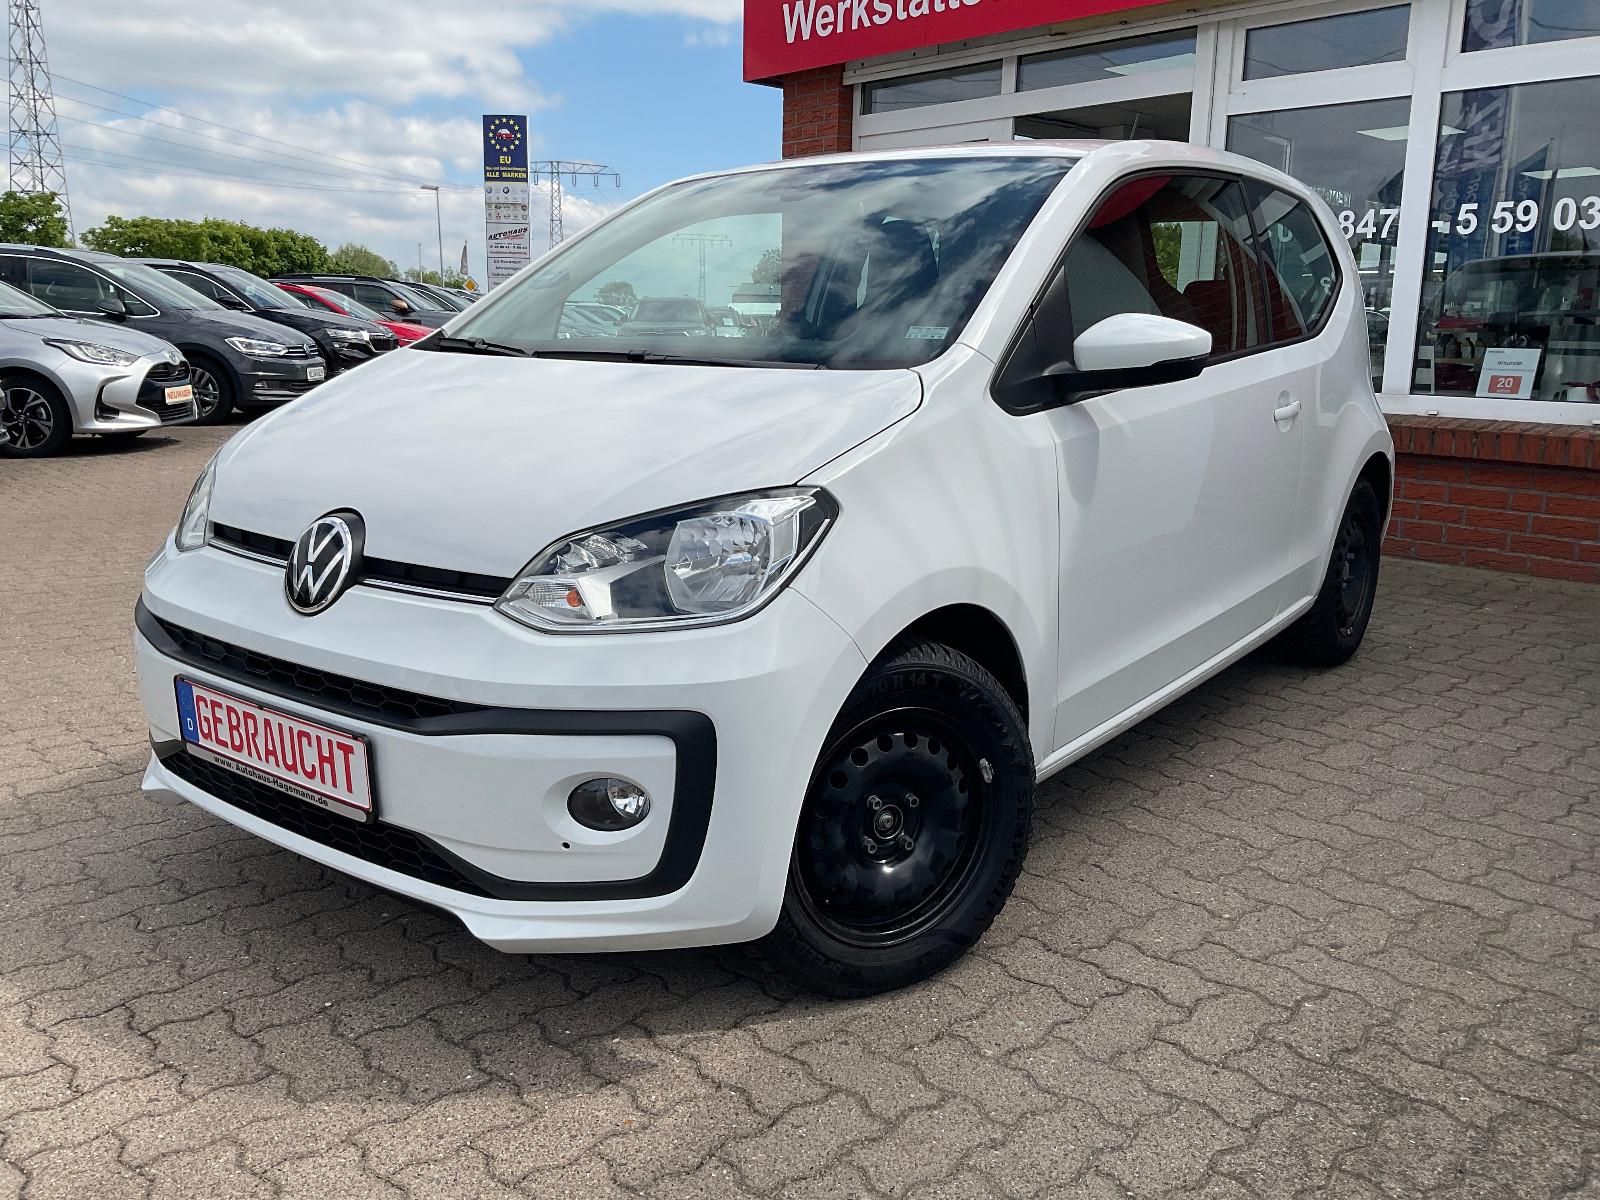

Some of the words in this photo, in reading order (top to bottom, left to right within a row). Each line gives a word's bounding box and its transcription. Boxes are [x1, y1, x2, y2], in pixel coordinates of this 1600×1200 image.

[783, 0, 980, 44] Werksta
[499, 155, 512, 164] EU
[1456, 203, 1479, 235] 5
[1491, 200, 1539, 234] 59
[1553, 196, 1600, 231] 03
[488, 227, 528, 240] AUTOHAUS
[1496, 377, 1514, 388] 20
[187, 717, 194, 731] D
[195, 694, 355, 794] GEBRAUCHT
